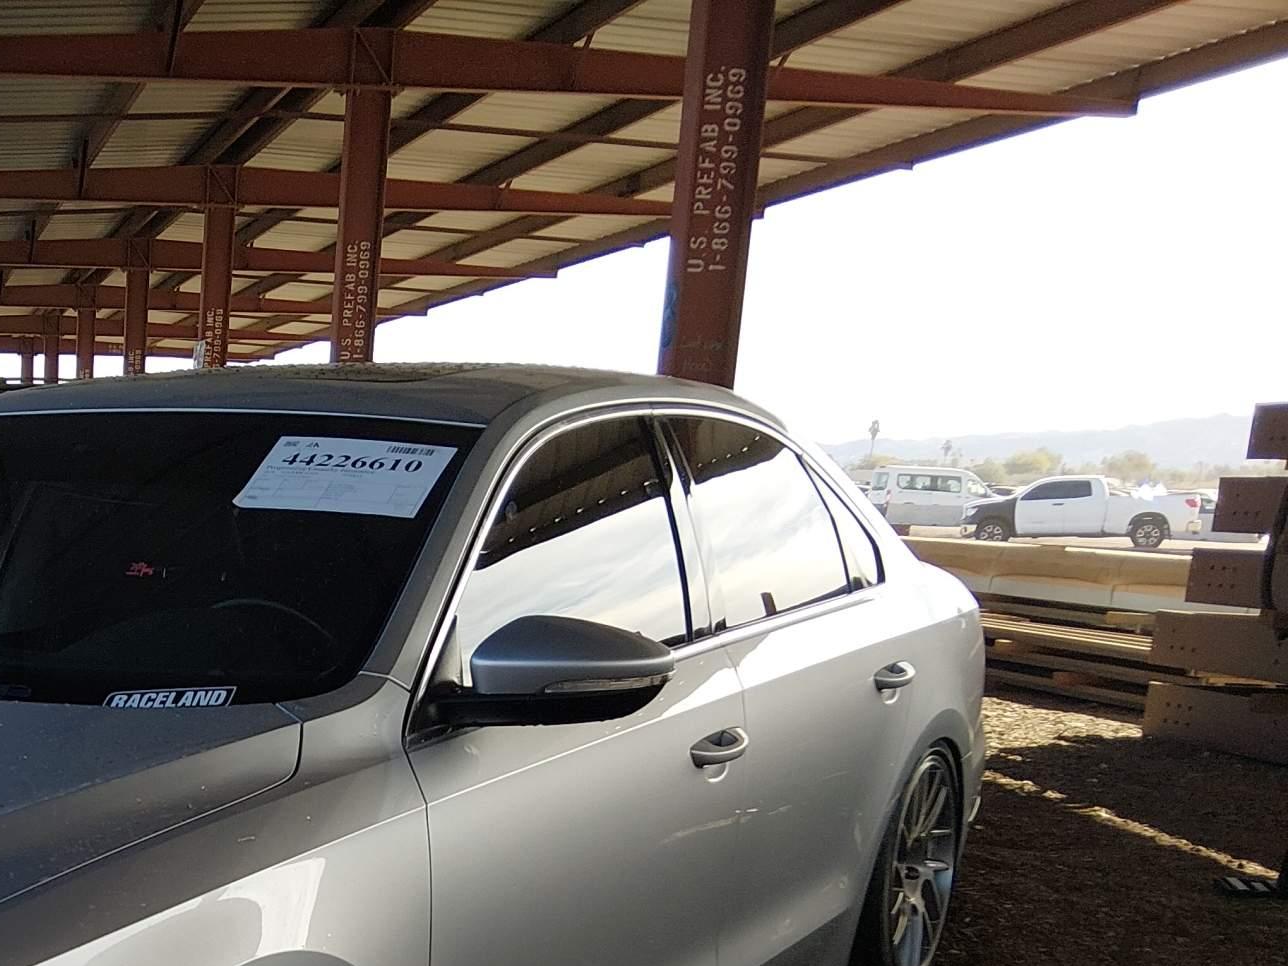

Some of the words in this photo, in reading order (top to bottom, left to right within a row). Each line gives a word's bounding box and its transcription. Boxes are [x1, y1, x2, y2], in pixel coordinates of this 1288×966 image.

[704, 65, 727, 110] INC.
[693, 124, 720, 215] PREFAB
[709, 67, 747, 271] 1-866-799-0969
[346, 240, 359, 266] INC.
[206, 307, 215, 327] INC.
[342, 273, 356, 326] PREFAB
[353, 241, 371, 359] 1-866-799-0969
[282, 452, 423, 473] 44226610
[110, 690, 228, 708] RACELAND
